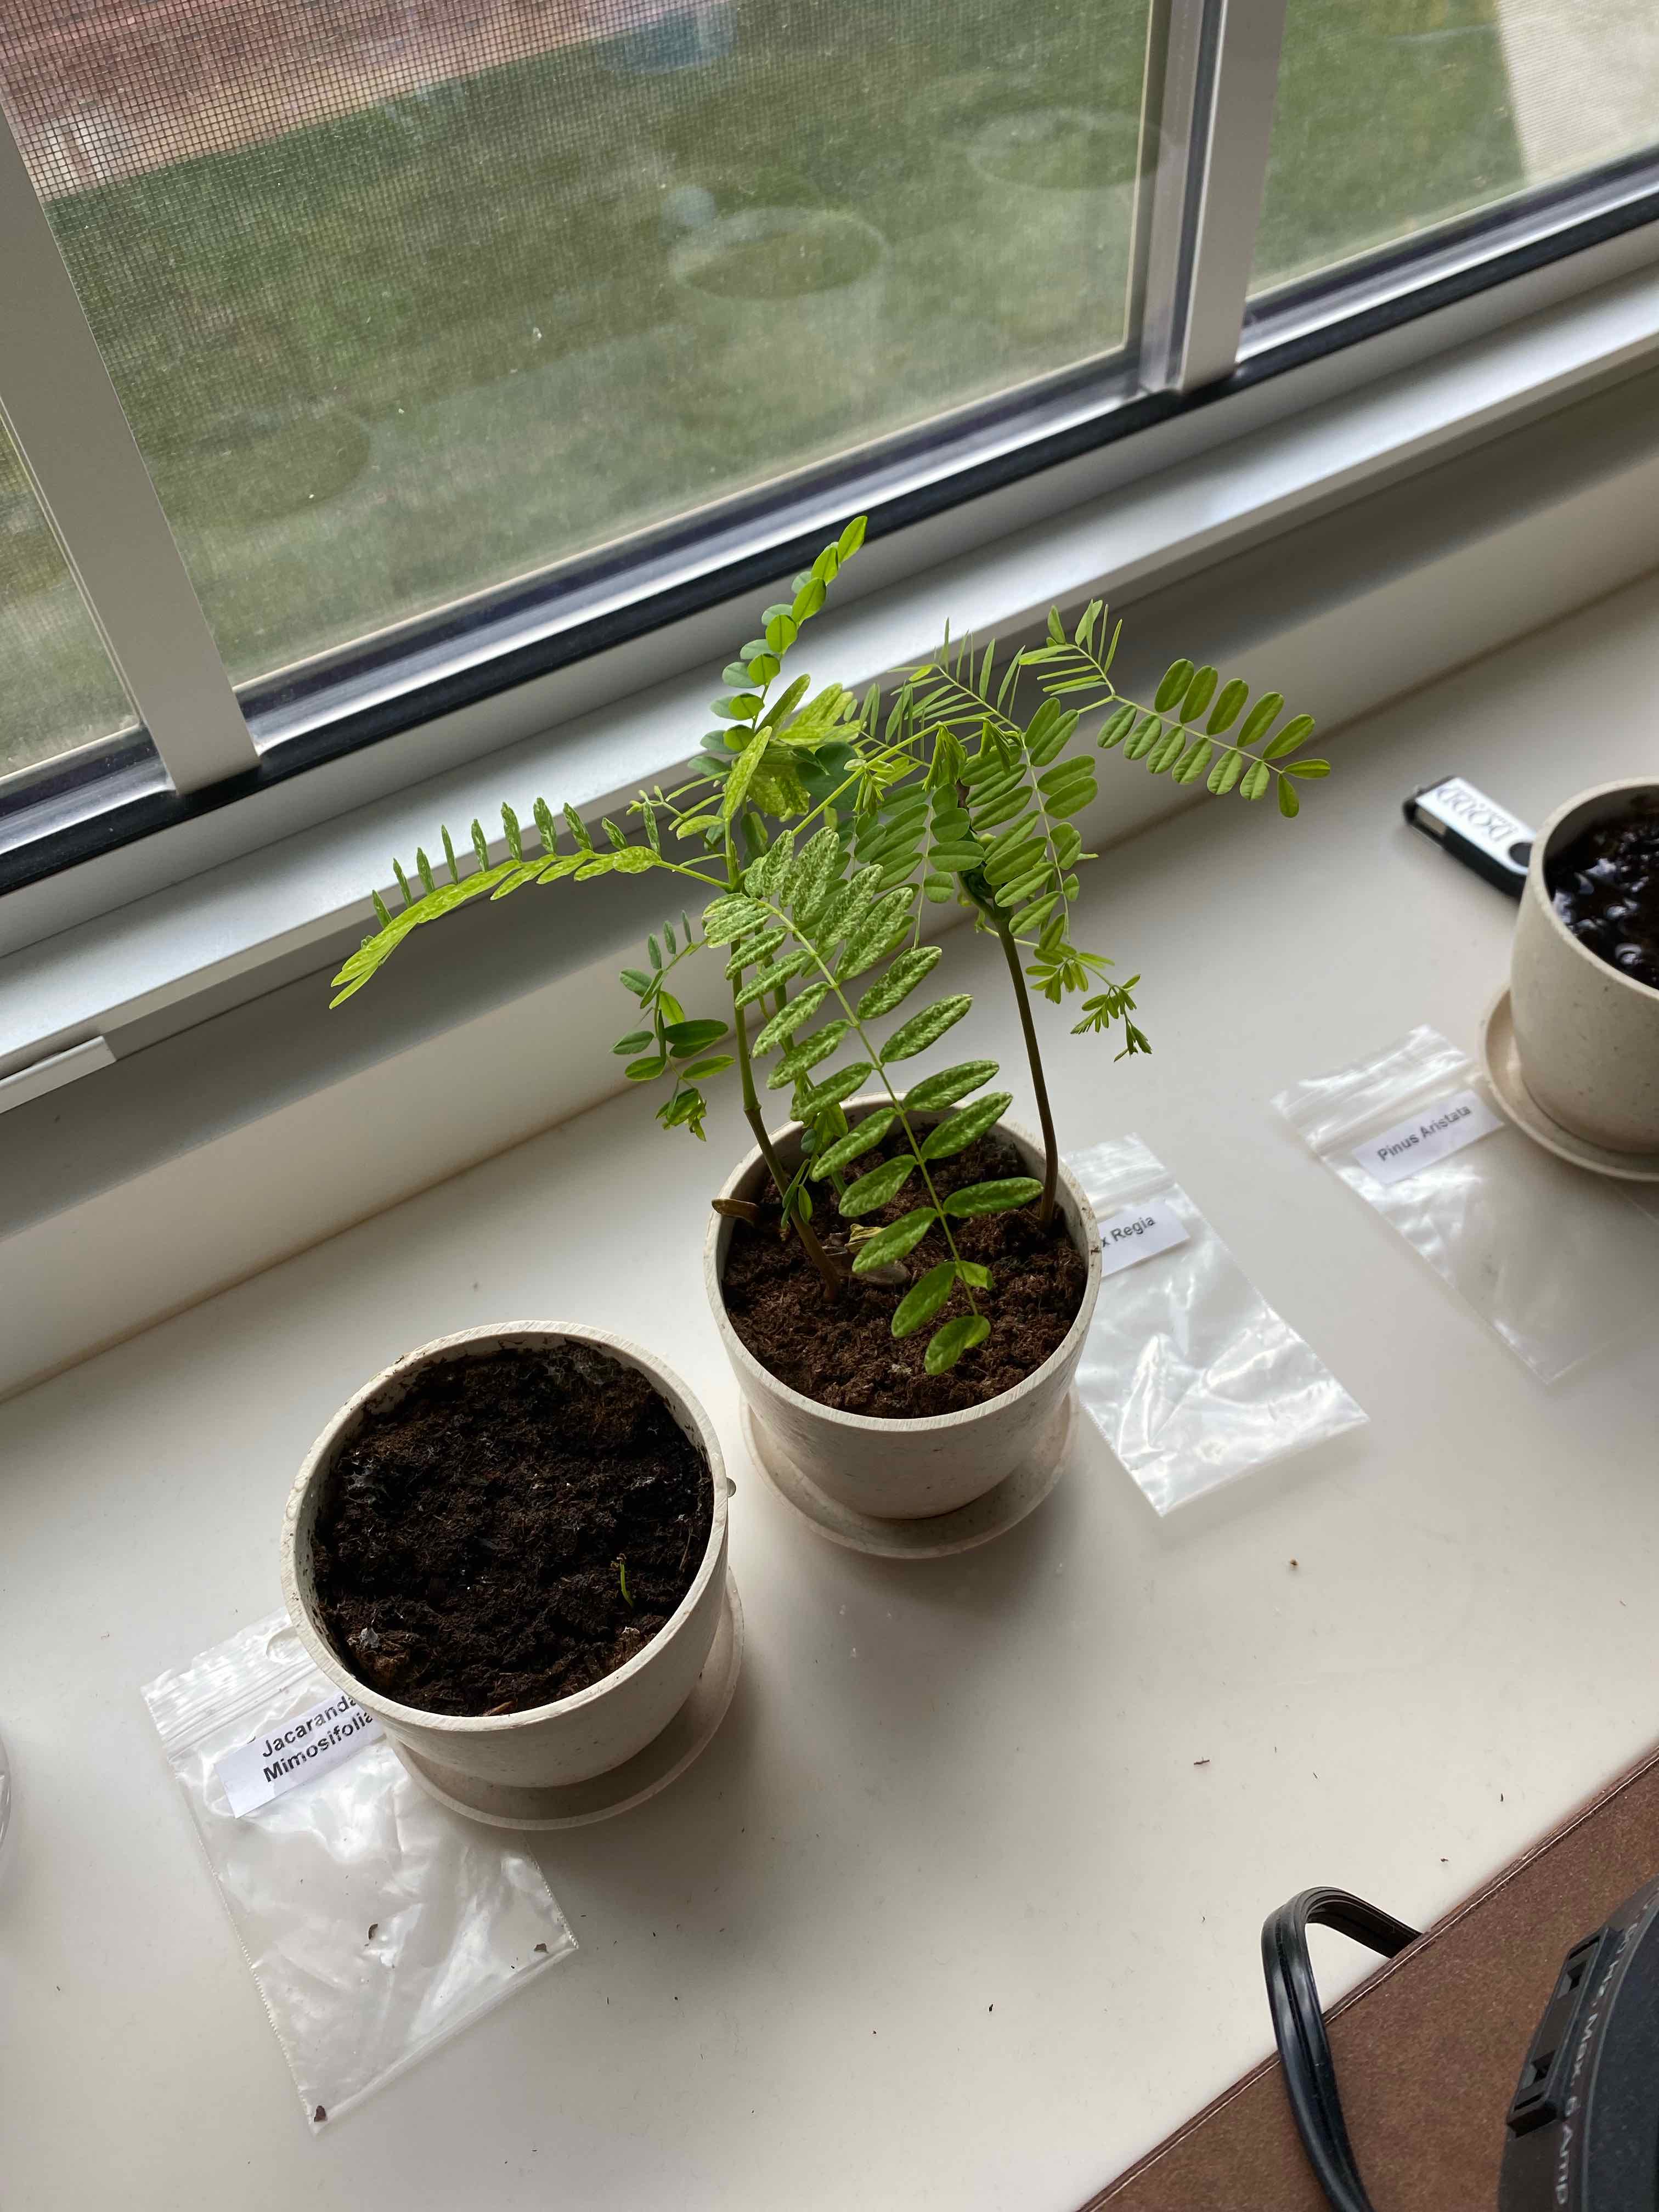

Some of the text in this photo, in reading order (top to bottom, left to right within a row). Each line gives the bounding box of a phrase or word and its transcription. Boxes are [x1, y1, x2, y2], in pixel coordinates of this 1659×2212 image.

[1377, 1106, 1471, 1161] Pinus Aristata
[1110, 1217, 1156, 1241] Regia
[262, 1695, 357, 1757] Jacaranda
[263, 1712, 373, 1782] Mimosifolia
[1556, 2124, 1573, 2205] Amp
